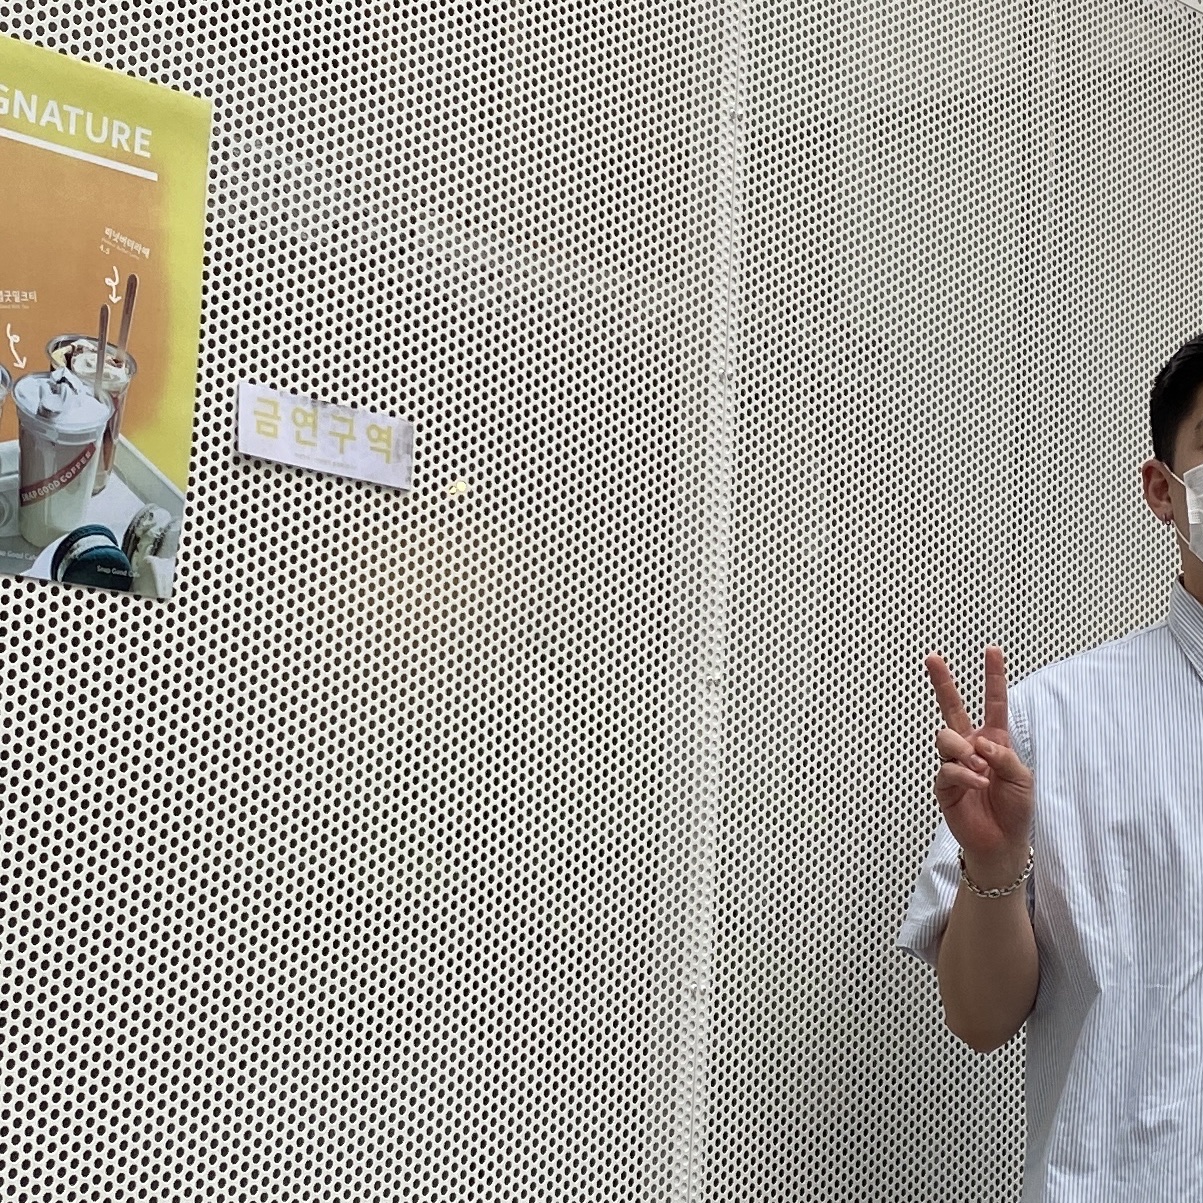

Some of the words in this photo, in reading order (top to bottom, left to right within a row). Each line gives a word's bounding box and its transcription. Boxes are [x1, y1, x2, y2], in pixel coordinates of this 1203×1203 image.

[0, 289, 37, 303] 굿밀크티
[253, 396, 393, 465] 금연구역
[37, 480, 61, 496] GOOD
